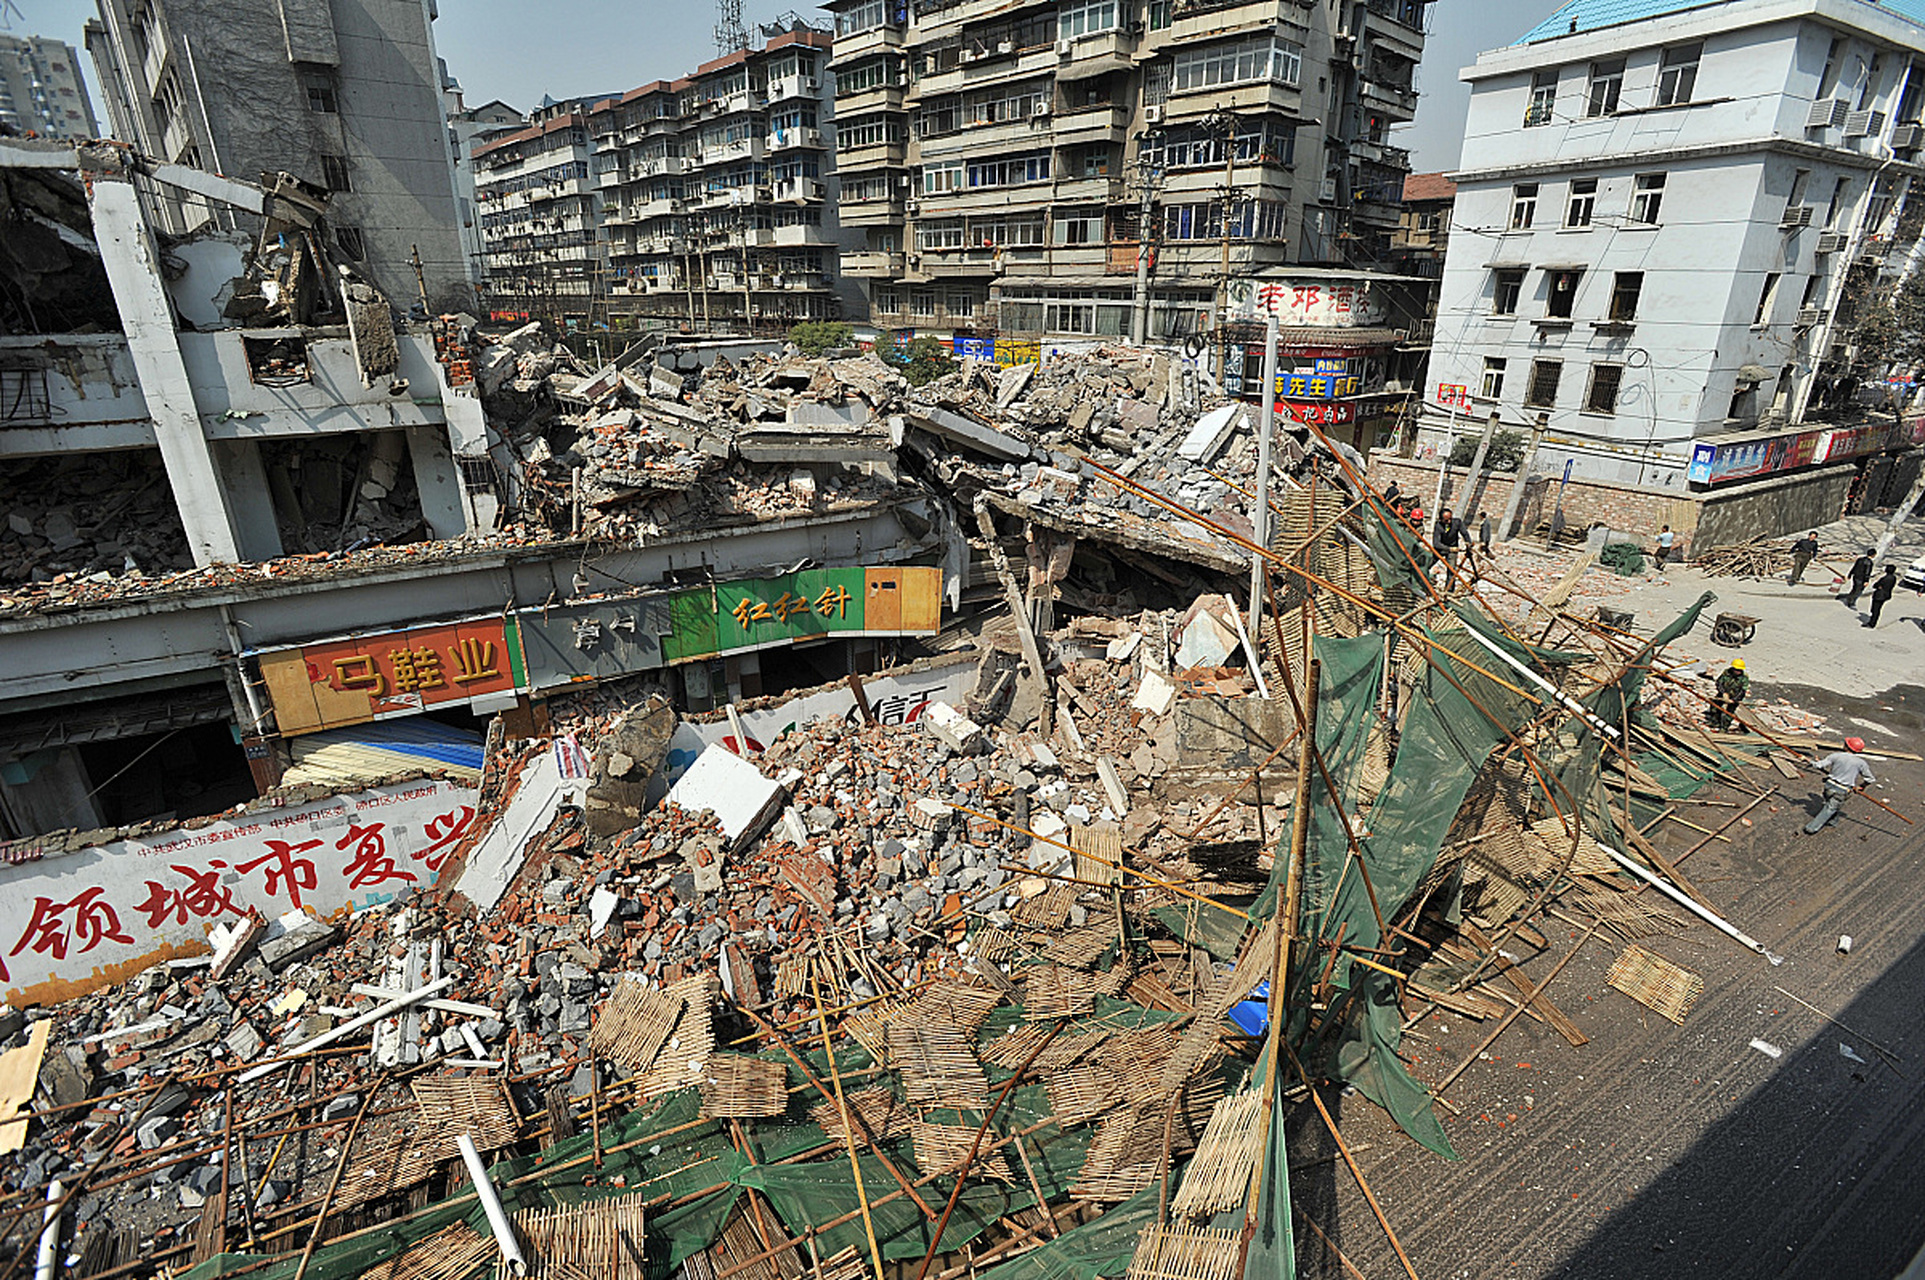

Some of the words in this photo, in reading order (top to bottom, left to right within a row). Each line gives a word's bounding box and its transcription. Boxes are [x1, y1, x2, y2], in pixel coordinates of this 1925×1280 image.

[733, 585, 852, 629] 红红针
[332, 637, 498, 697] 马鞋业
[0, 805, 476, 982] 领城市复兴
